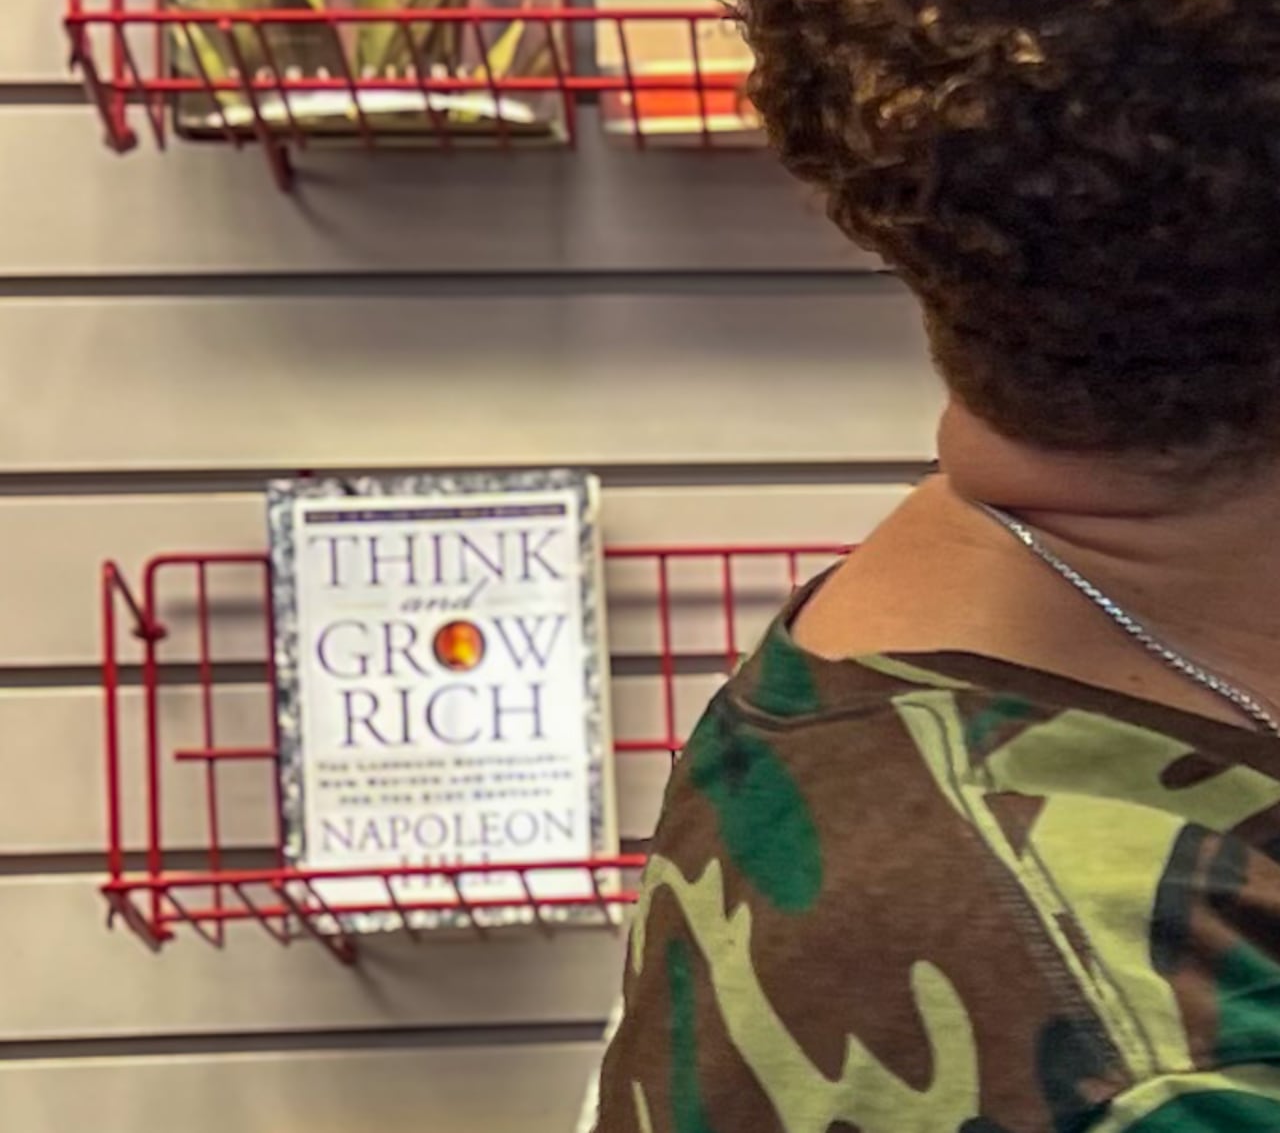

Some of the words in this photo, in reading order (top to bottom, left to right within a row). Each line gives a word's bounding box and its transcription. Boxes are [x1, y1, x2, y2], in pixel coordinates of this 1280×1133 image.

[308, 528, 568, 589] THINK
[400, 577, 490, 613] and
[315, 614, 571, 680] GROW
[341, 682, 548, 748] RICH
[320, 808, 575, 852] NAPOLEON
